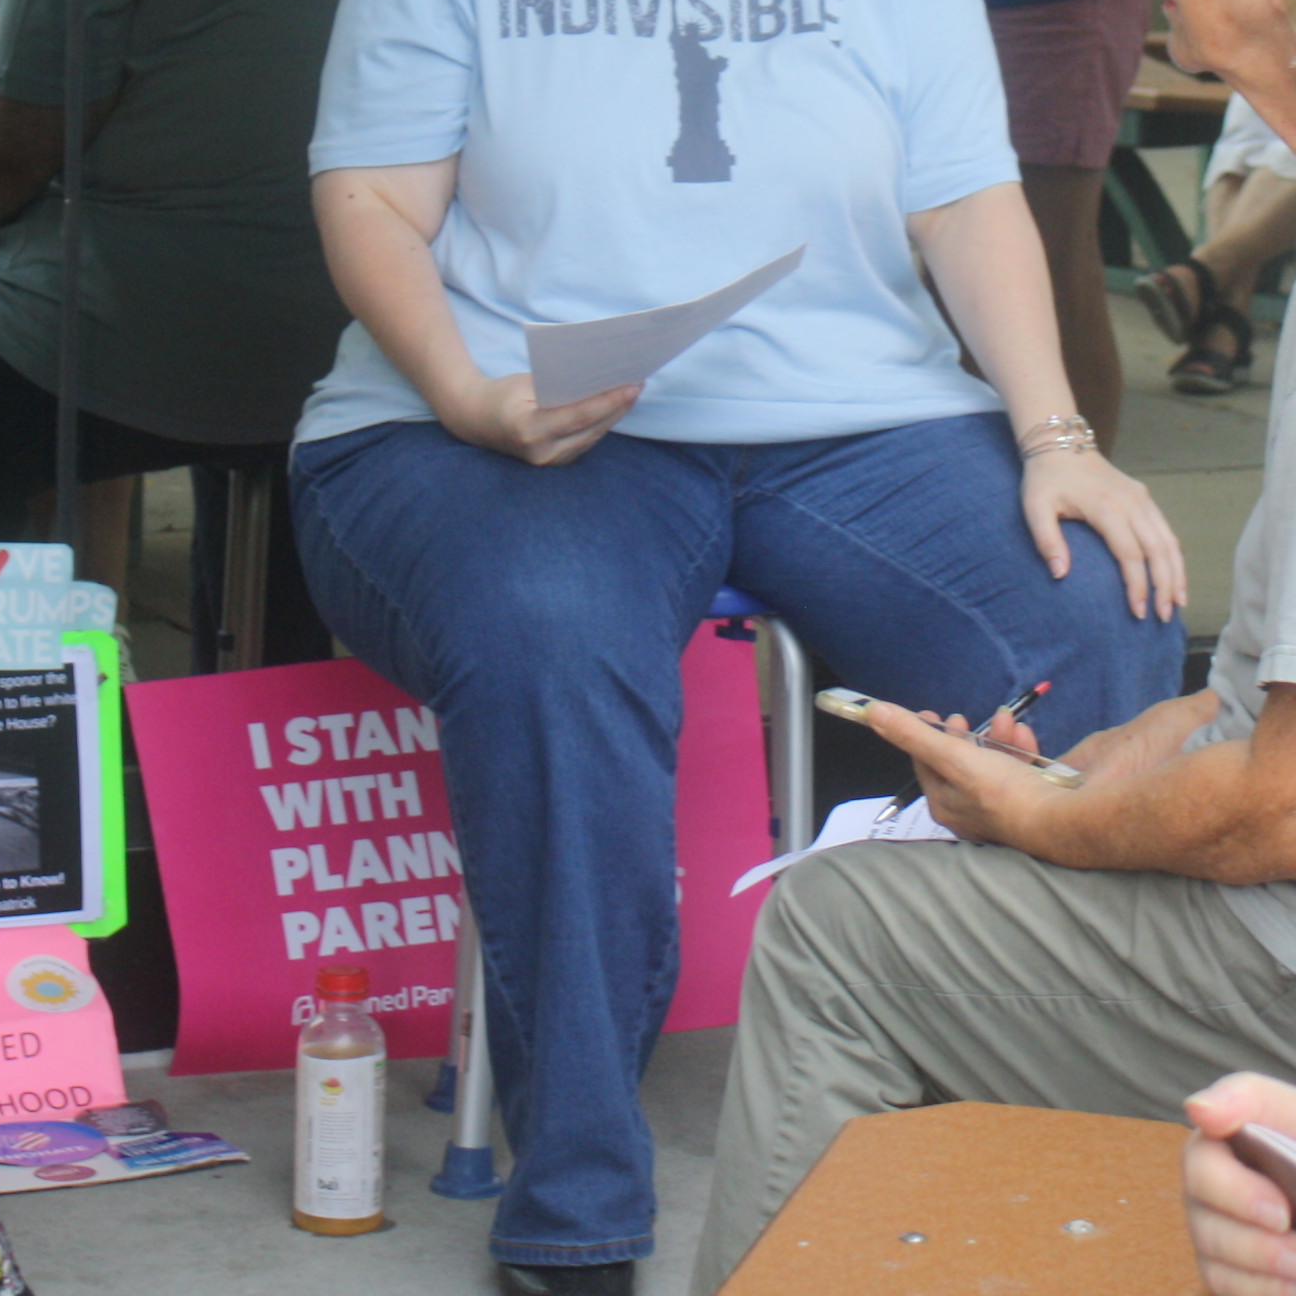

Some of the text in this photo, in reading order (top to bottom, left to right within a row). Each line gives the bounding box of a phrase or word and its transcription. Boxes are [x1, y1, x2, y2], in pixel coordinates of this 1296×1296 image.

[45, 671, 67, 685] the
[4, 697, 19, 709] to
[5, 713, 57, 731] House?
[248, 706, 441, 770] I STAN
[259, 770, 424, 832] WITH
[2, 876, 18, 889] to
[19, 872, 66, 888] Know!
[270, 830, 463, 897] PLANN
[281, 894, 462, 961] PAREN
